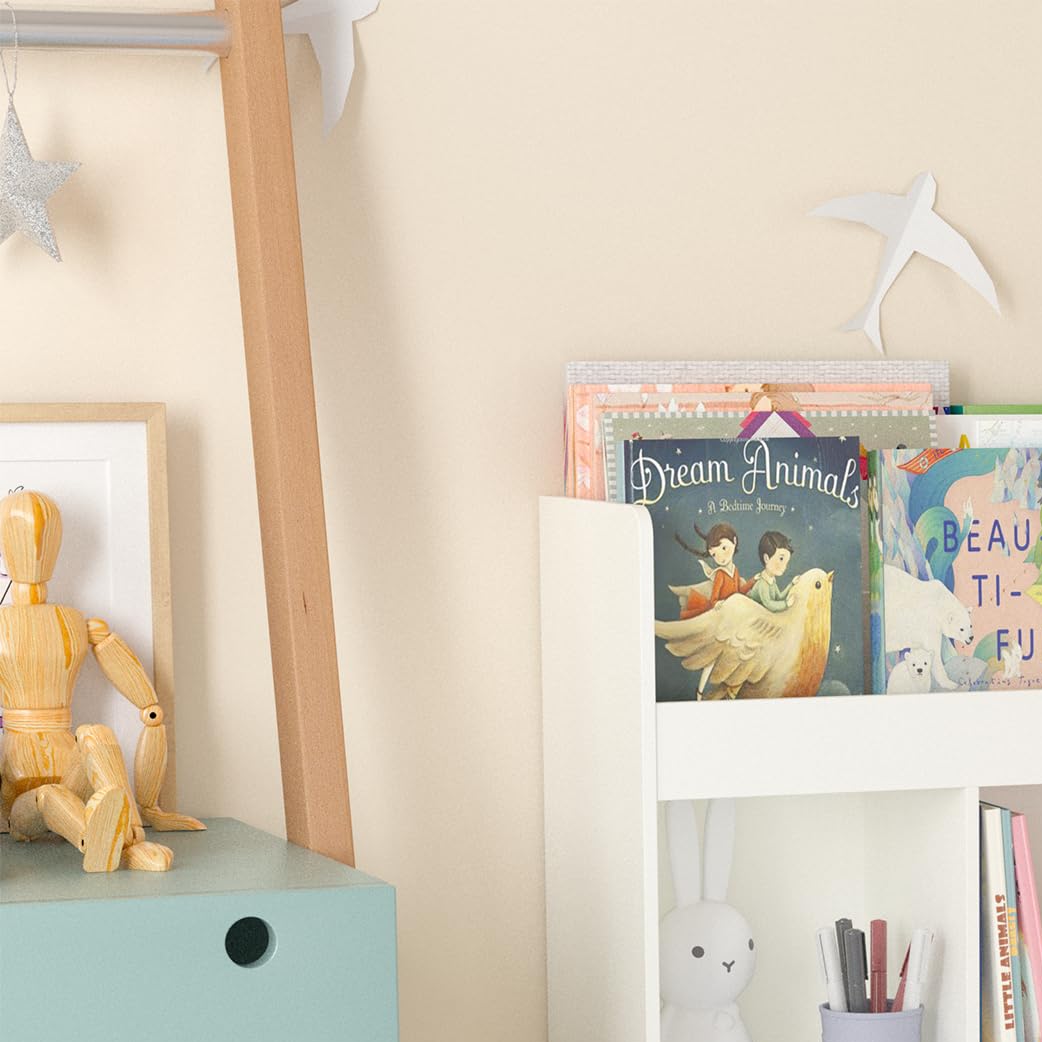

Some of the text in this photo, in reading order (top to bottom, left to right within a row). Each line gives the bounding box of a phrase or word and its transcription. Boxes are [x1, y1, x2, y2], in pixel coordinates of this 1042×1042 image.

[630, 440, 859, 509] Dream Animals
[707, 497, 788, 517] A Bedtime Journey
[971, 574, 1022, 607] TI-
[995, 894, 1011, 967] ANIMALS
[1001, 972, 1015, 1030] LITTLE
